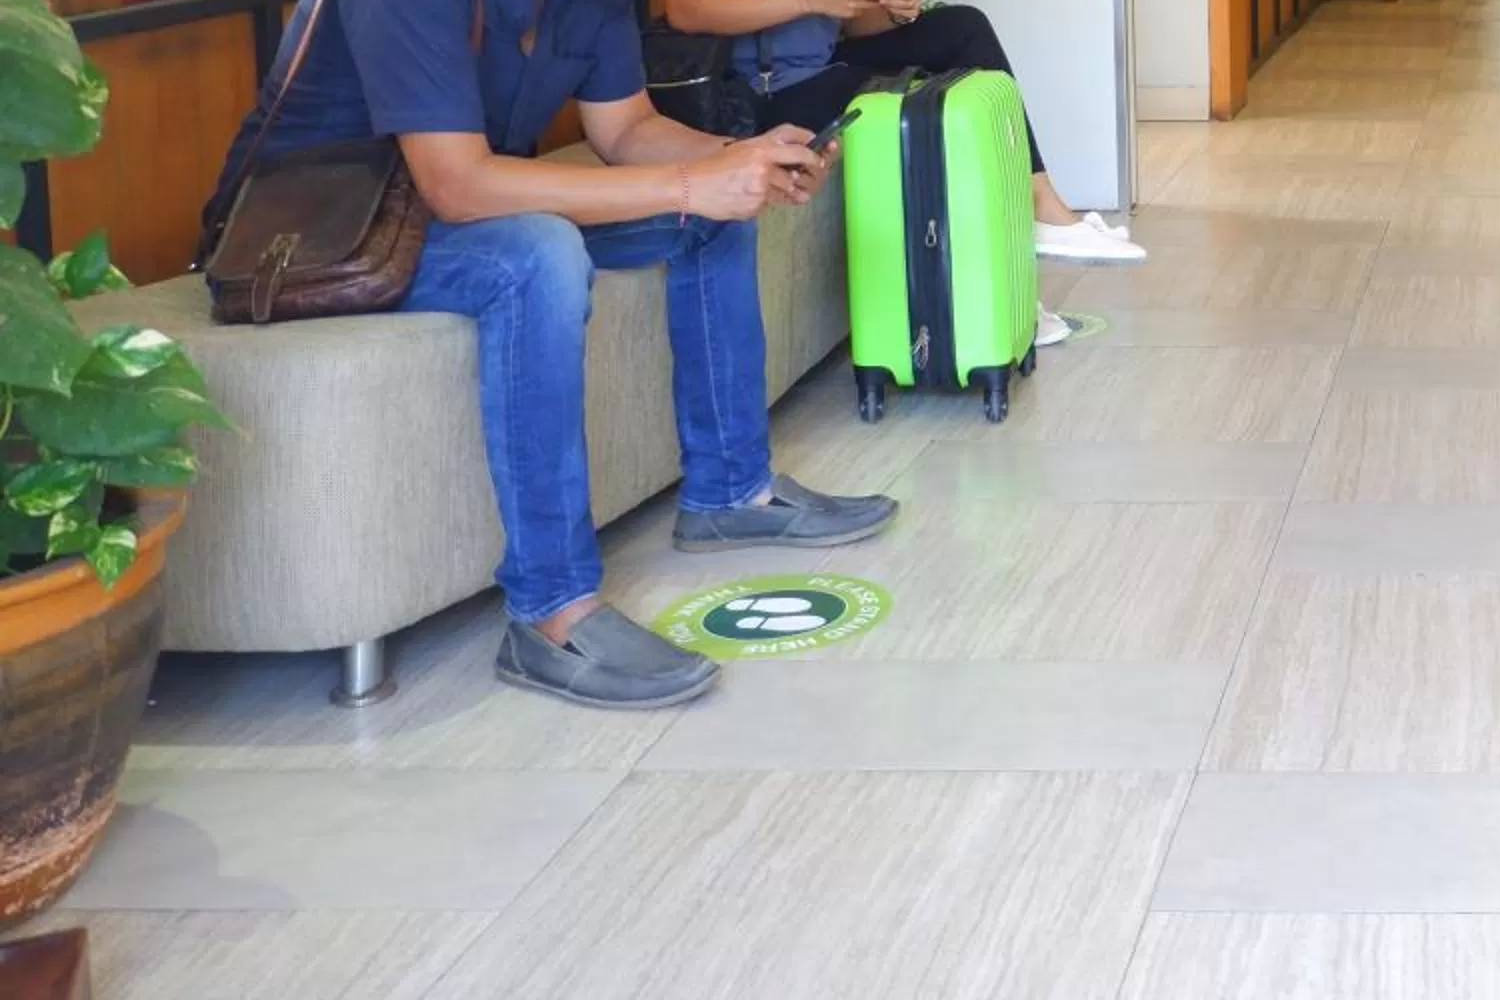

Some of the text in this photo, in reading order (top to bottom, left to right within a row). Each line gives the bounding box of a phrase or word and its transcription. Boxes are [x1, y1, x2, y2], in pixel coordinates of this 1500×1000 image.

[741, 577, 881, 653] PLEASE STAND HERE
